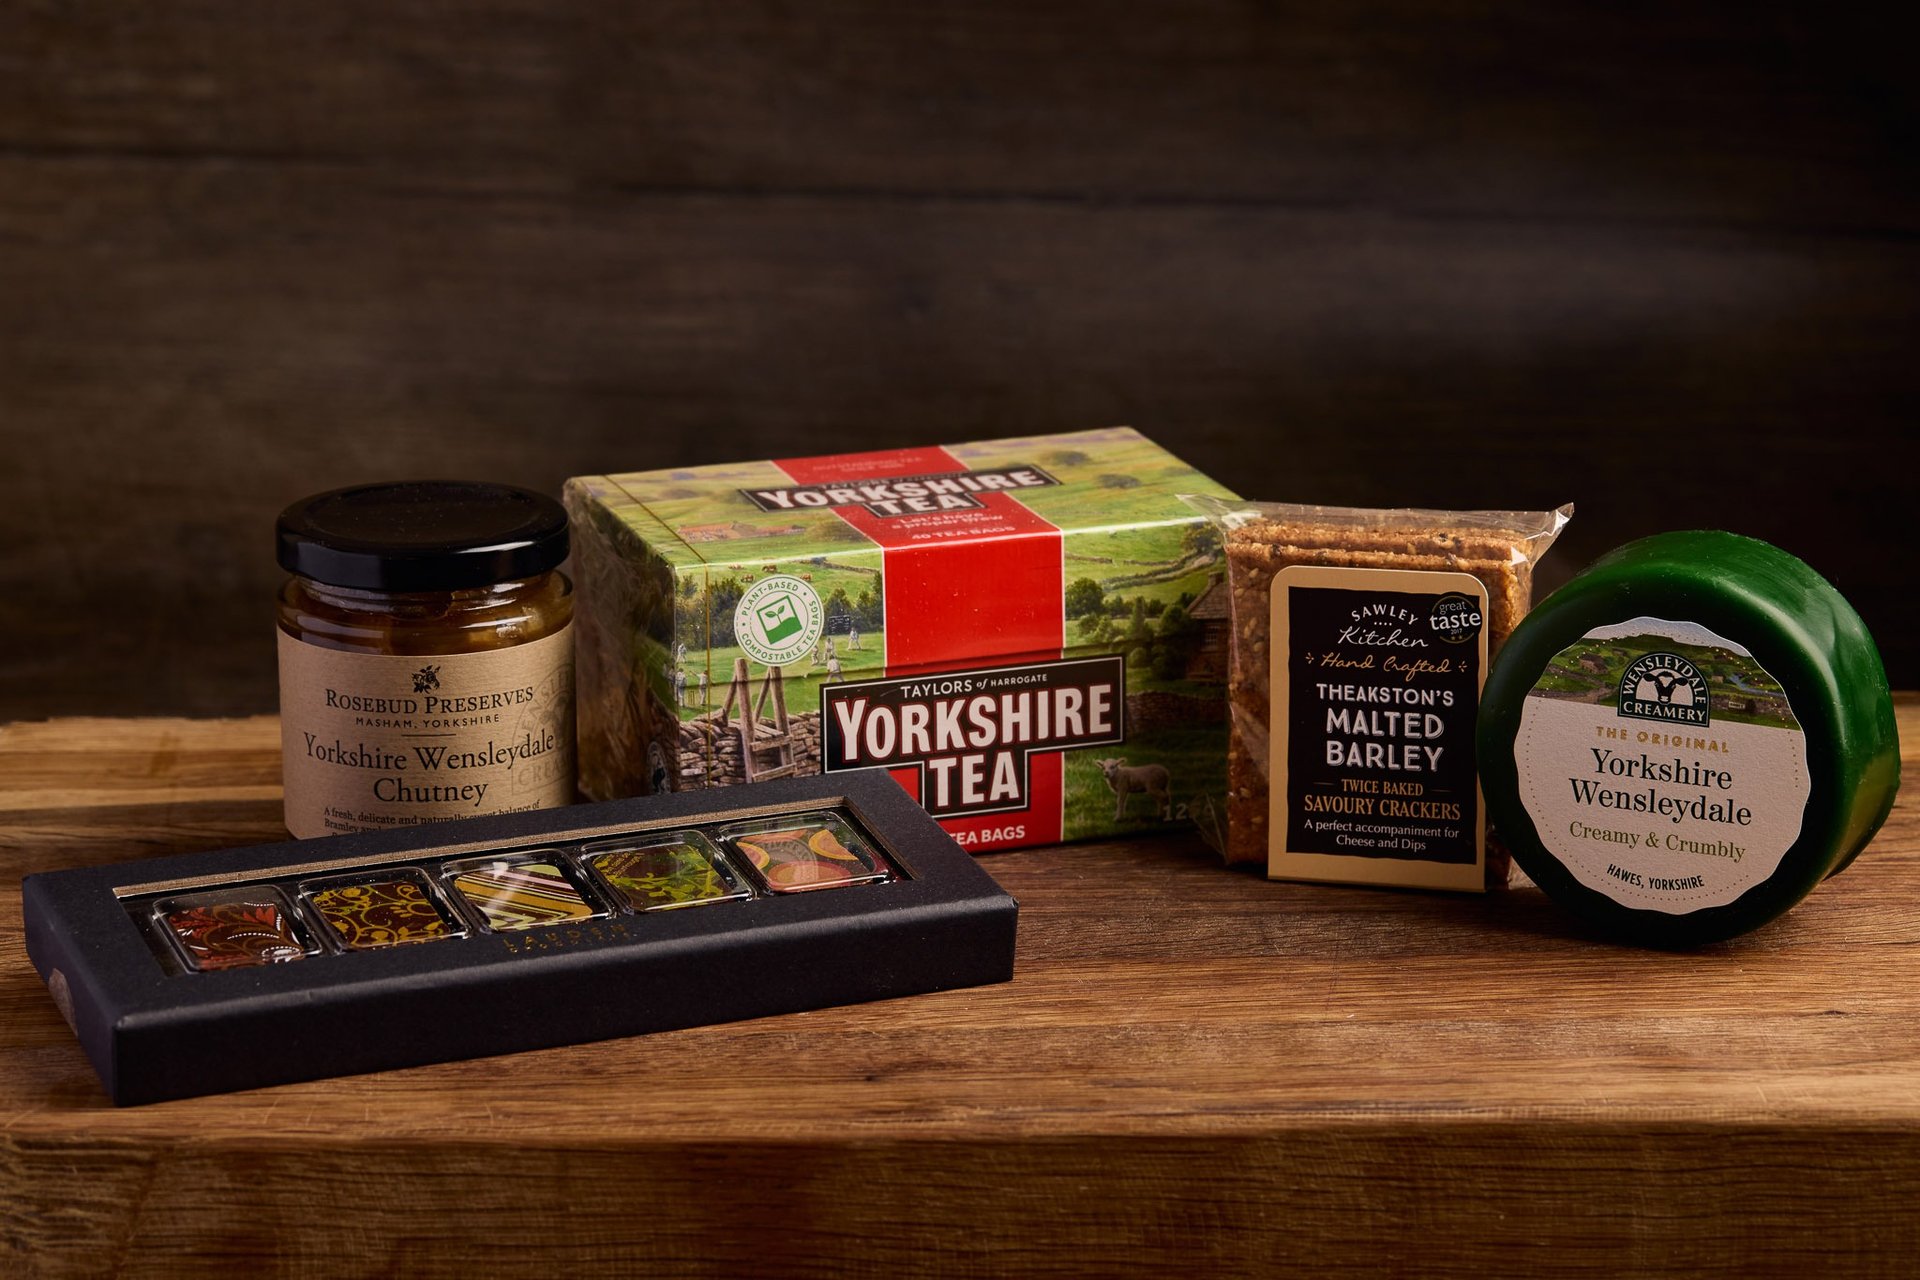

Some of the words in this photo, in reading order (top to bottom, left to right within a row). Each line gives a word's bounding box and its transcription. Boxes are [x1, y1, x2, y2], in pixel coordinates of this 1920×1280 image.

[757, 469, 1045, 509] YORKSHIRE
[869, 493, 975, 515] TEA
[932, 530, 969, 538] TEA
[970, 526, 1017, 535] BAGS
[741, 581, 799, 616] PLANT-BASED
[1439, 601, 1467, 616] great
[808, 600, 819, 626] BAGS
[1350, 603, 1419, 626] SAWLEY
[1429, 611, 1482, 631] taste
[741, 632, 803, 661] COMPOSTABLE
[803, 629, 816, 647] TEA
[1337, 625, 1430, 648] Kitchen
[1319, 651, 1376, 669] Hand
[1382, 655, 1453, 683] Crafted
[1621, 655, 1707, 705] WENSLEYDALE
[900, 678, 973, 699] TAYLORS
[975, 678, 989, 690] of
[989, 673, 1048, 688] HARROGATE
[1315, 682, 1455, 707] THEAKSTON'S
[325, 688, 418, 714] ROSEBUD
[424, 686, 534, 714] PRESERVES
[1622, 700, 1707, 723] CREAMERY
[355, 717, 418, 729] MASHAM,
[422, 713, 500, 729] YORKSHIRE
[833, 683, 1113, 761] YORKSHIRE
[1326, 707, 1446, 741] MALTED
[303, 731, 408, 771] Yorkshire
[412, 728, 554, 771] Wensleydale
[1596, 726, 1628, 741] THE
[1636, 730, 1730, 754] ORIGINAL
[1326, 739, 1444, 773] BARLEY
[1589, 746, 1733, 790] Yorkshire
[373, 776, 488, 807] Chutney
[927, 750, 1021, 808] TEA
[1341, 778, 1380, 795] TWICE
[1383, 780, 1424, 797] BAKED
[1303, 794, 1376, 816] SAVOURY
[1379, 799, 1461, 821] CRACKERS
[1568, 778, 1752, 826] Wensleydale
[324, 807, 331, 816] A
[331, 807, 357, 822] fresh,
[357, 811, 397, 825] delicate
[398, 815, 418, 825] and
[1303, 818, 1314, 830] A
[1315, 819, 1353, 834] perfect
[1355, 823, 1442, 838] accompaniment
[1443, 826, 1460, 839] for
[980, 825, 1026, 843] BAGS
[1335, 833, 1376, 849] Cheese
[1377, 838, 1399, 849] and
[1401, 838, 1427, 853] Dips
[1569, 820, 1641, 849] Creamy
[1645, 831, 1660, 849] &
[1665, 833, 1746, 864] Crumbly
[1606, 863, 1645, 889] HAWES,
[1647, 874, 1705, 891] YORKSHIRE
